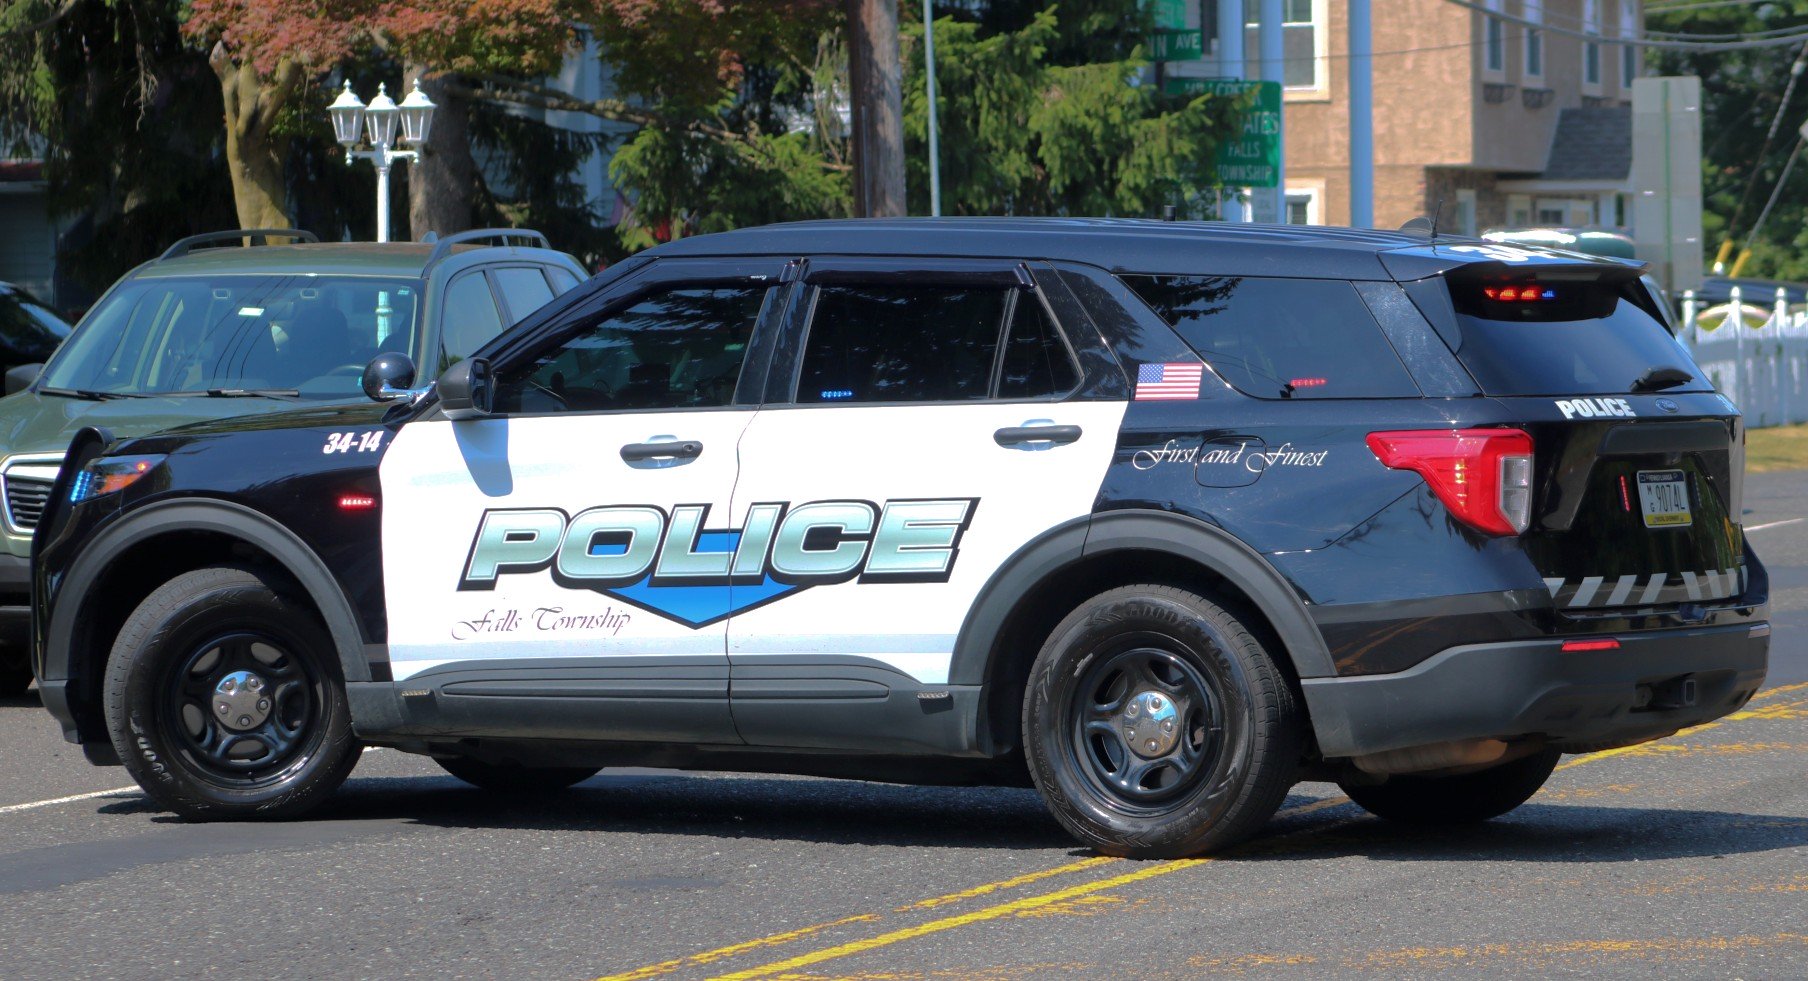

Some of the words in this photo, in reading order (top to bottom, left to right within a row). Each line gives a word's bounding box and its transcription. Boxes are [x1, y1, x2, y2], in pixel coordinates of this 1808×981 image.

[1175, 32, 1202, 50] AVE
[1228, 141, 1261, 158] FALLS
[1217, 165, 1273, 181] TOWNSHIP
[1554, 398, 1637, 419] POLICE
[323, 430, 384, 455] 34-14
[1132, 438, 1200, 471] First
[1200, 442, 1246, 465] and
[1245, 442, 1329, 473] Finest
[456, 497, 982, 592] POLICE
[451, 608, 523, 641] Falls
[531, 606, 631, 637] Township
